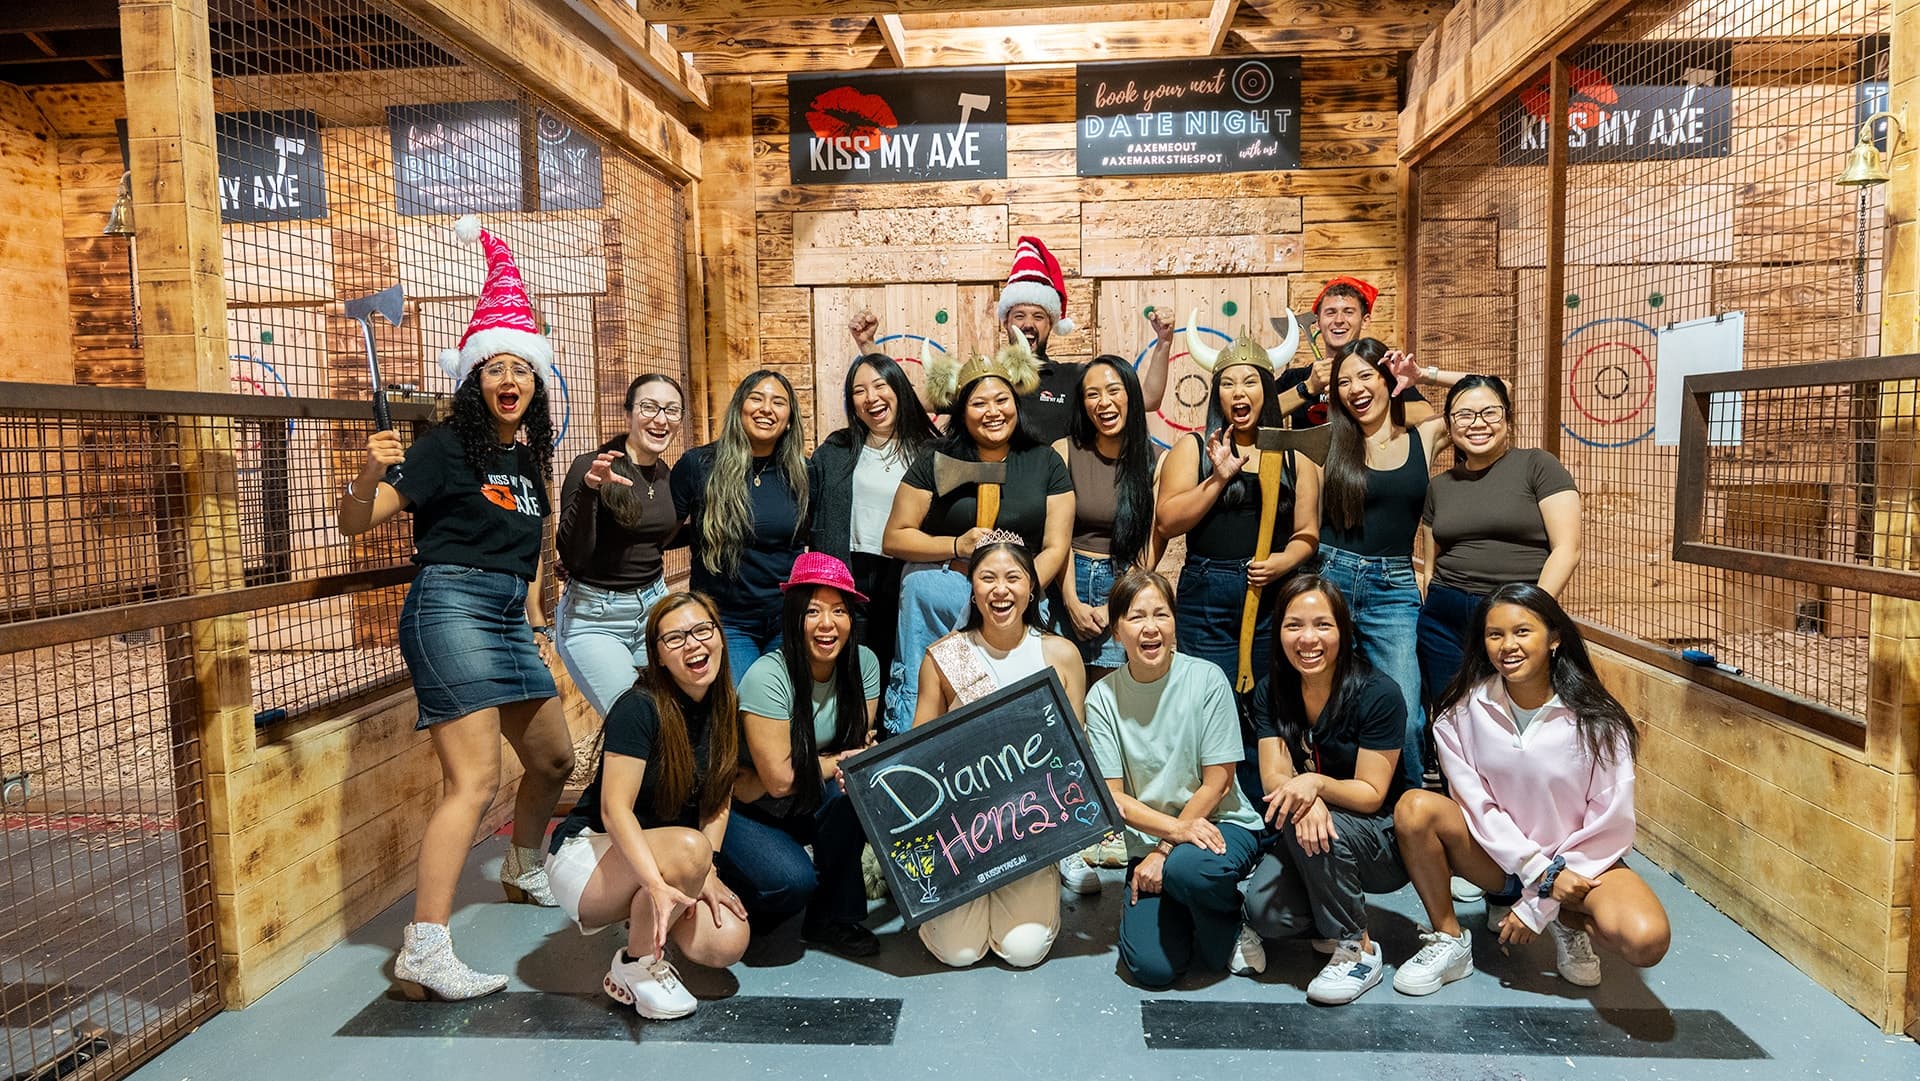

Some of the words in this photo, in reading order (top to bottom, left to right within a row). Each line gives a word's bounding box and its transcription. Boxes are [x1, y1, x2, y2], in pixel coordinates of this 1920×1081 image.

[1096, 81, 1139, 108] book
[1143, 85, 1186, 111] your
[1190, 68, 1226, 95] next
[1085, 112, 1174, 139] DATE
[1185, 109, 1292, 136] NIGHT
[1520, 112, 1587, 150] KIS
[1597, 109, 1641, 147] MY
[1649, 107, 1705, 147] AXE
[404, 147, 588, 181] BIRTHAY
[809, 136, 871, 171] KISS
[880, 133, 920, 169] MY
[929, 131, 981, 169] AXE
[1101, 153, 1224, 167] #AXEMARKSTHESPOT
[1127, 142, 1198, 154] #AXEMEOUT
[1239, 140, 1262, 159] with
[1262, 141, 1279, 156] us!
[253, 174, 300, 210] AXE
[488, 473, 510, 485] KISS
[514, 494, 540, 517] AXE
[935, 772, 1070, 876] Hens!
